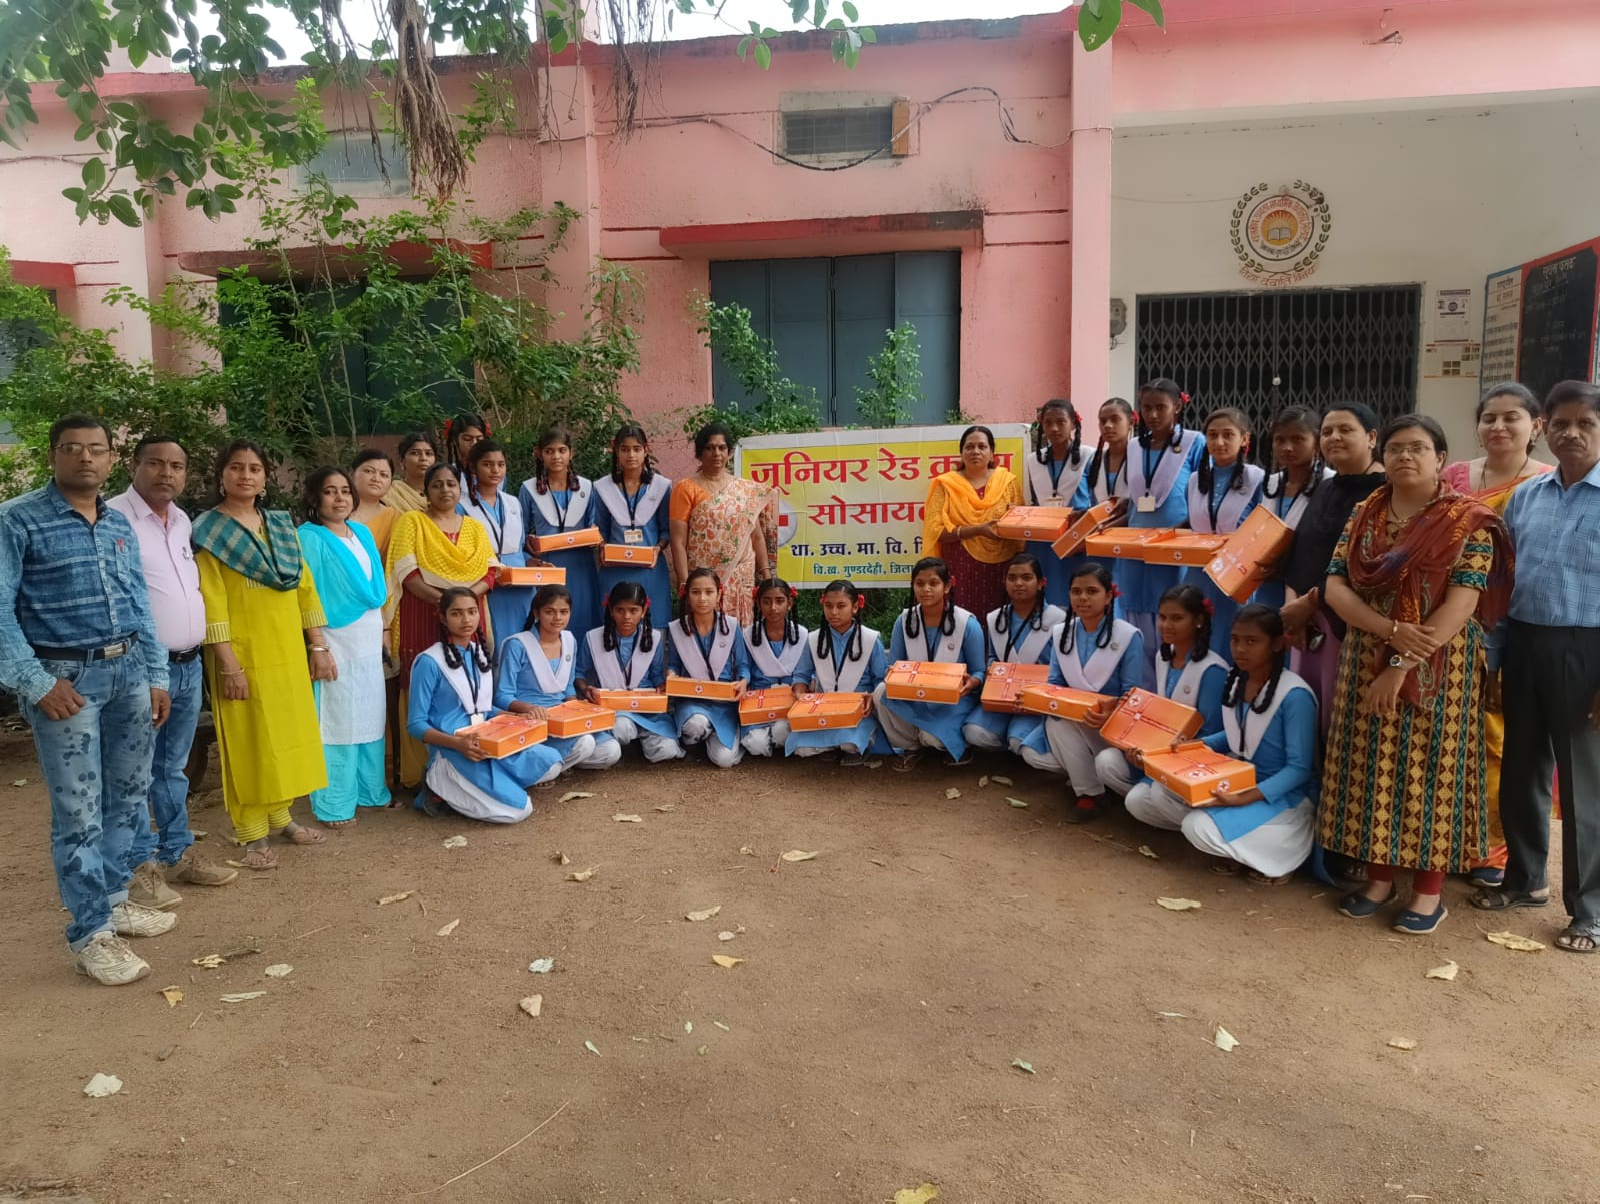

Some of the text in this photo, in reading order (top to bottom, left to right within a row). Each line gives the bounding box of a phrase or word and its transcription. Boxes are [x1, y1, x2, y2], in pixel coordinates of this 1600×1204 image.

[750, 450, 870, 495] जूनियर
[876, 447, 921, 481] रेड
[808, 495, 925, 526] सोसाय
[791, 543, 814, 557] शा.
[820, 543, 851, 557] उच्च.
[857, 542, 880, 556] मा.
[886, 536, 908, 555] वि.
